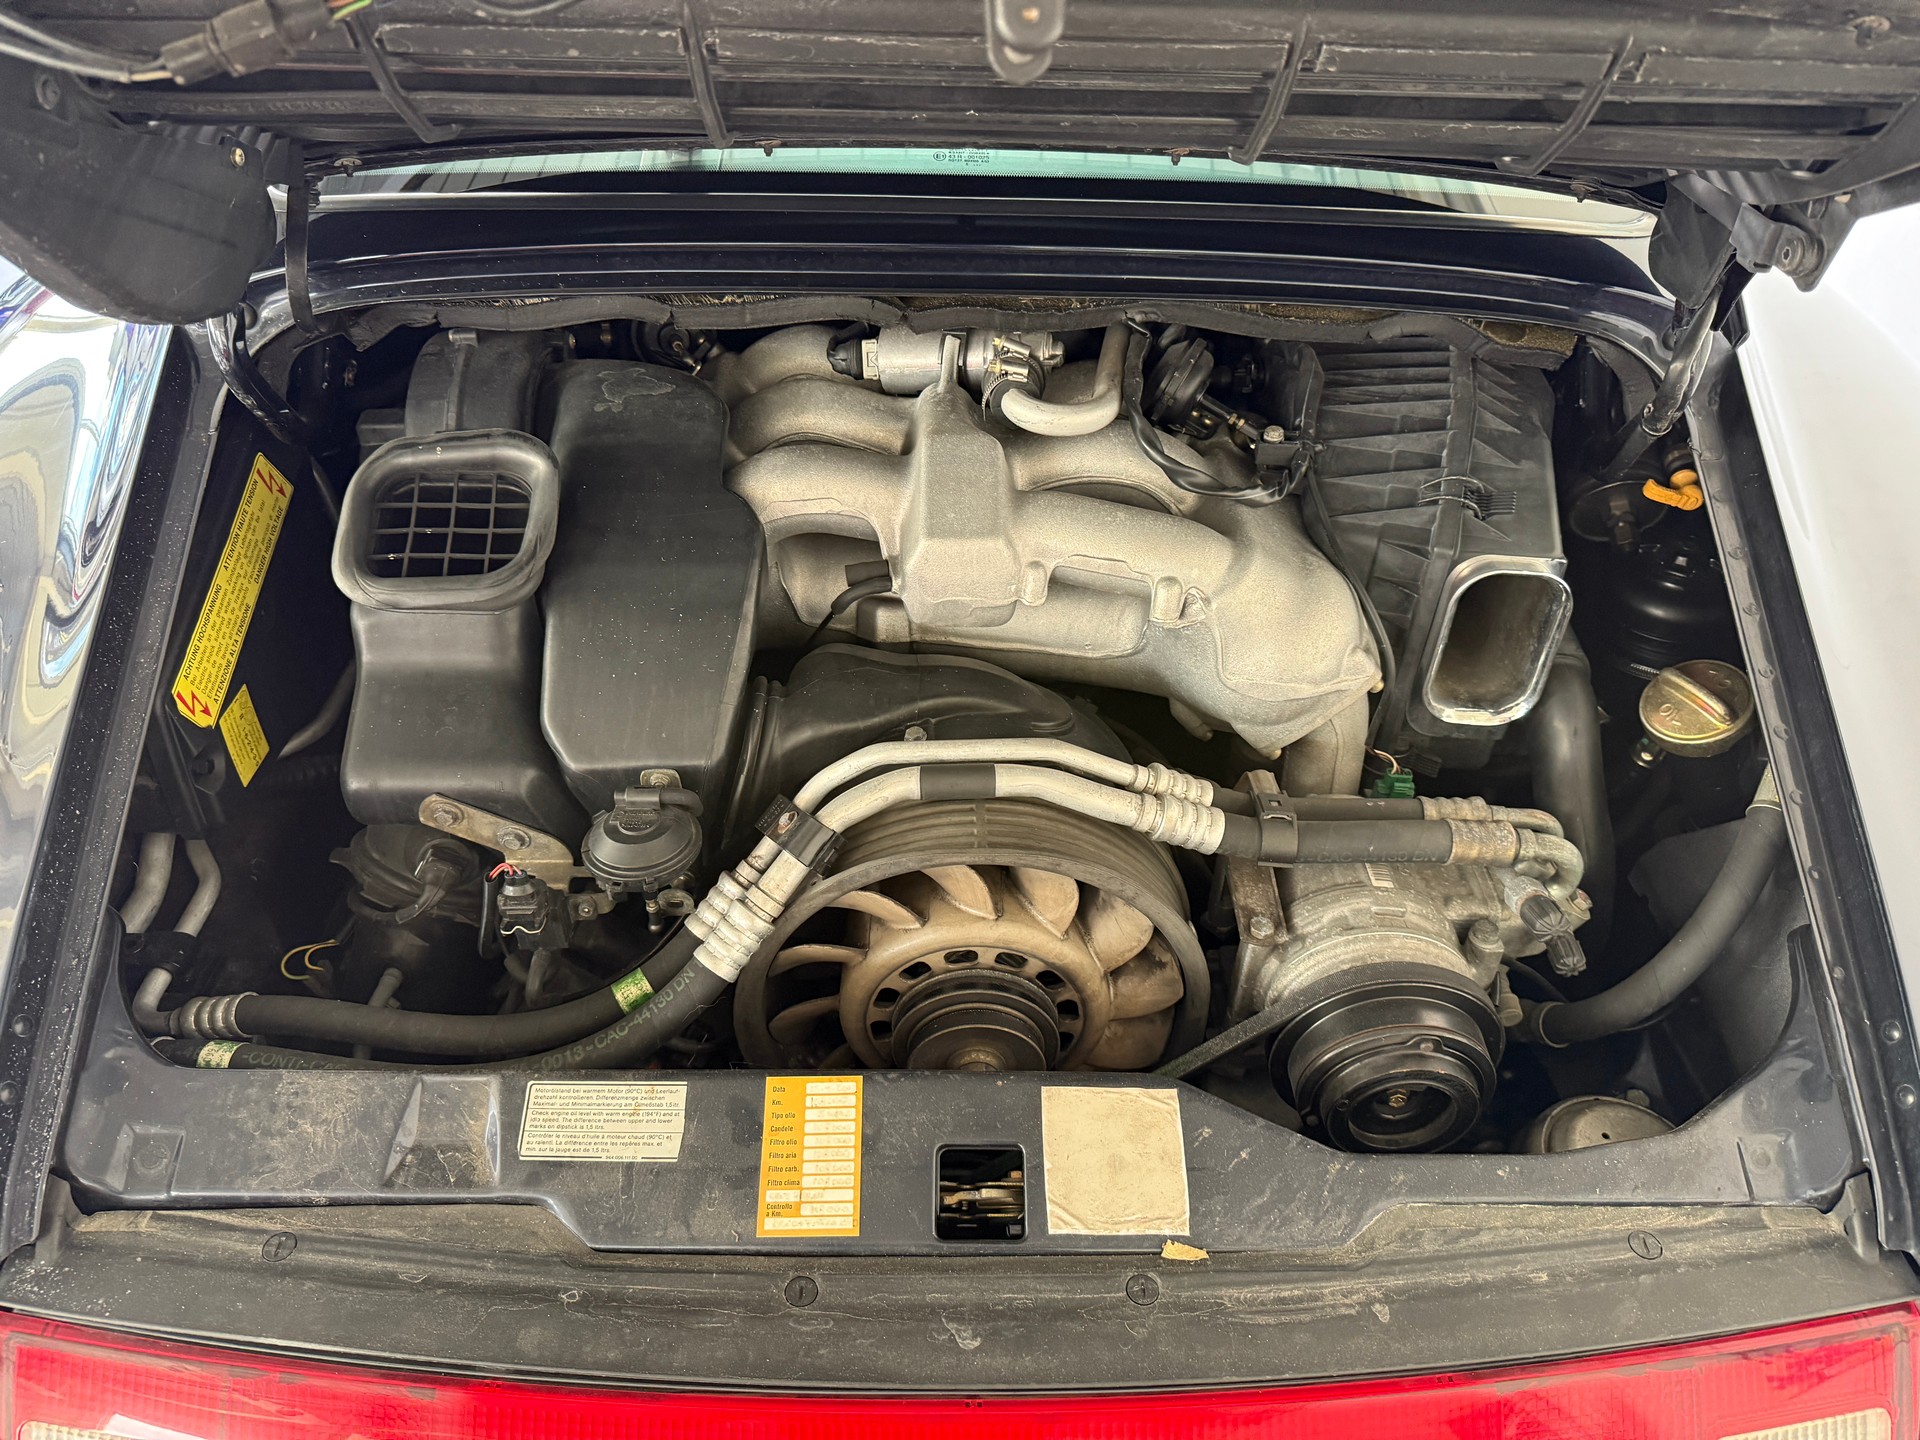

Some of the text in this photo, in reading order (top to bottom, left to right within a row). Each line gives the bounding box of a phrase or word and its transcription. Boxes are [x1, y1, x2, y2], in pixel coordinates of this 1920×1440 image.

[223, 478, 258, 571] ATTENTION HAUTE TENSION
[254, 505, 283, 584] DANGER HIGH VOLTAGE
[183, 584, 221, 681] ACHTUNG HOCHSPANNUNG
[196, 645, 208, 672] Arbeiten
[207, 634, 212, 642] an
[216, 588, 229, 618] gesamten
[196, 665, 207, 690] Electric
[206, 645, 215, 663] shock
[214, 616, 225, 642] suffered
[231, 572, 241, 595] working
[202, 671, 213, 694] Danger
[211, 659, 217, 668] de
[222, 631, 227, 640] en
[230, 606, 235, 615] de
[213, 602, 251, 704] ATTENZIONE ALTA TENSIONE
[674, 968, 696, 992] DN
